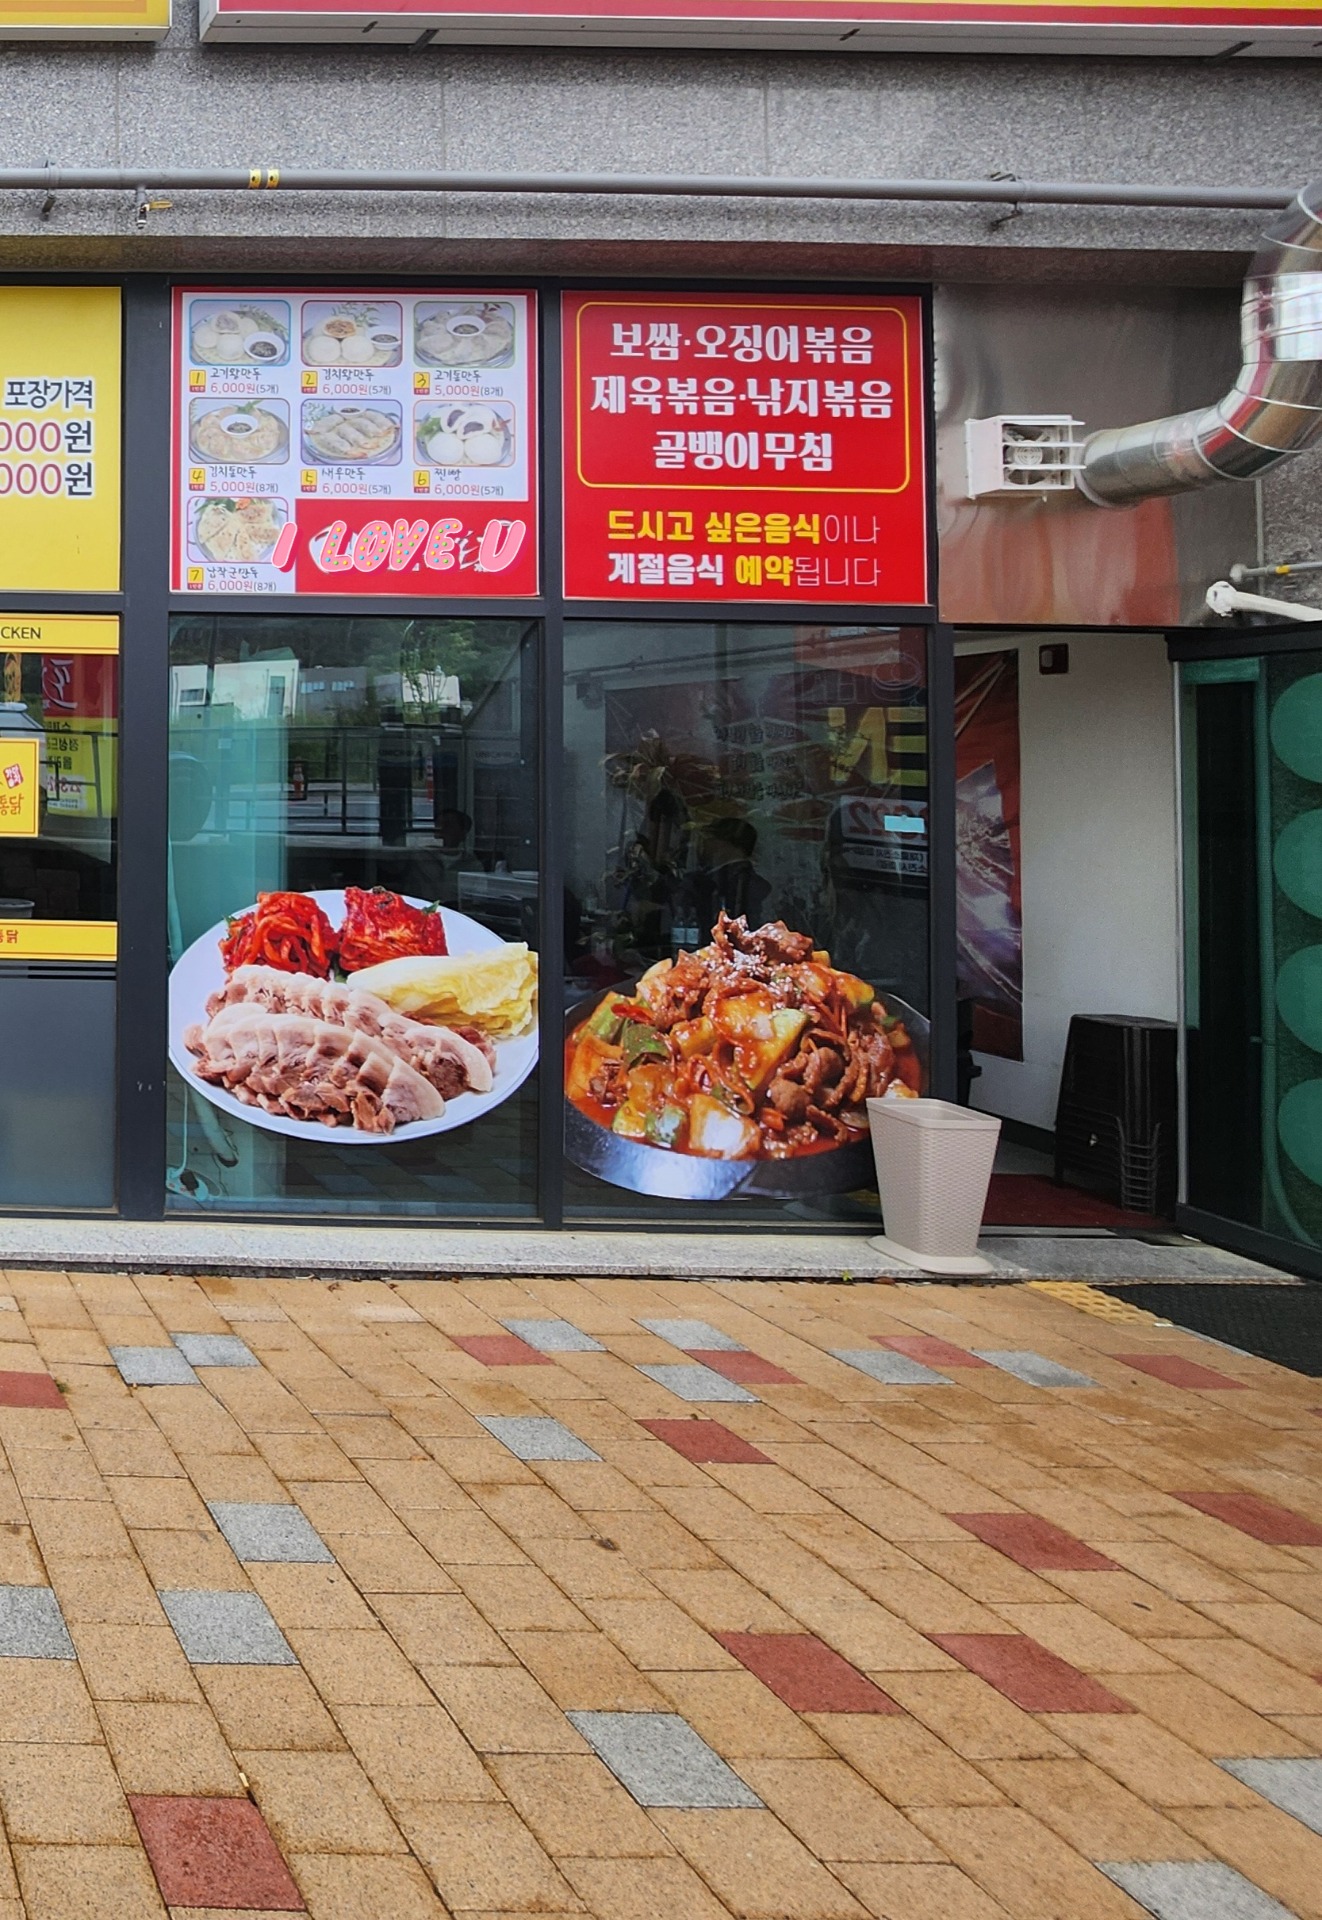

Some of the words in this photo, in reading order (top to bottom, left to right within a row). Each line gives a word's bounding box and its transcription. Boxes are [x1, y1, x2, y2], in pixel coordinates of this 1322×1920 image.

[210, 367, 261, 381] 고기왕만두
[306, 373, 315, 385] 2
[321, 368, 374, 382] 김치왕만두
[417, 373, 427, 387] 3
[5, 379, 93, 409] 포장가격
[653, 431, 834, 471] 골뱅이무침
[192, 470, 203, 482] 4
[321, 467, 366, 481] 새우만두
[417, 472, 427, 486] 6
[433, 467, 462, 481] 찐빵
[608, 510, 694, 541] 드시고
[705, 511, 881, 544] 싶은음식이나
[191, 569, 201, 582] 7
[206, 566, 259, 580] 납작군만두
[608, 553, 724, 586] 계절음식
[735, 555, 881, 587] 예약됩니다
[0, 626, 42, 640] CKEN
